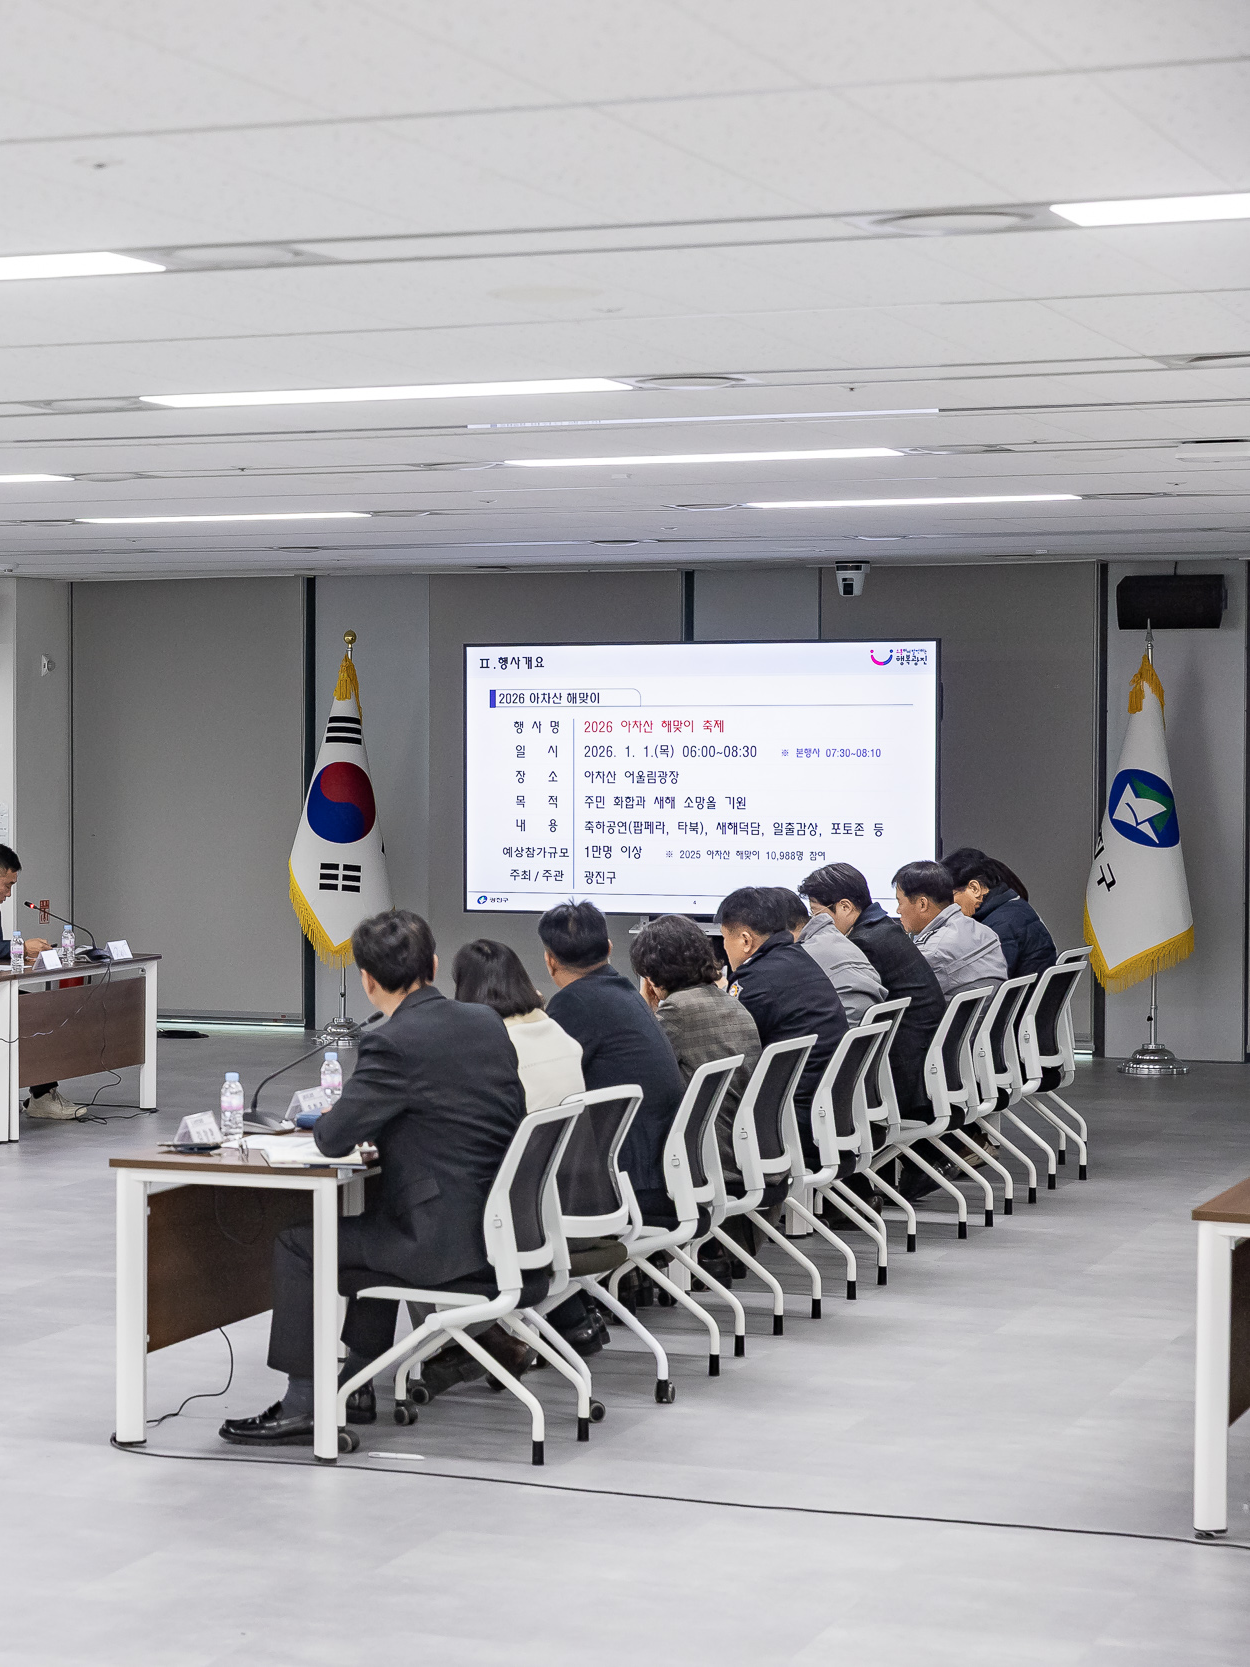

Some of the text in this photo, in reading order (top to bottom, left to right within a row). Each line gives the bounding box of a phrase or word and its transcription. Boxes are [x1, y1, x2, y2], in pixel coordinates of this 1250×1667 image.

[499, 693, 599, 704] 2026 아차산 해맞이
[584, 720, 724, 733] 2026 아차산 해맞이 축제
[585, 746, 616, 757] 2026.
[625, 746, 634, 757] 1.
[683, 746, 756, 757] 06:00~08:30
[796, 748, 820, 758] 본행사
[826, 749, 881, 757] 07:30~08:10
[585, 771, 679, 784] 아차산 어울림광장
[585, 796, 604, 809] 주민
[614, 796, 645, 809] 화합과
[654, 797, 675, 809] 새해
[725, 797, 746, 809] 기원
[716, 822, 764, 836] 새해덕담,
[773, 822, 821, 837] 일출감상,
[831, 823, 864, 836] 포토존
[874, 823, 883, 837] 등
[503, 847, 569, 858] 예상참가규모
[585, 846, 612, 859] 1만명
[621, 846, 642, 859] 이상
[680, 850, 701, 859] 2025
[707, 850, 730, 859] 아차산
[736, 851, 759, 859] 해맞이
[766, 851, 803, 861] 10,988명
[810, 852, 825, 861] 참여
[510, 869, 530, 881] 주최
[542, 870, 564, 881] 주관
[585, 871, 616, 884] 광진구
